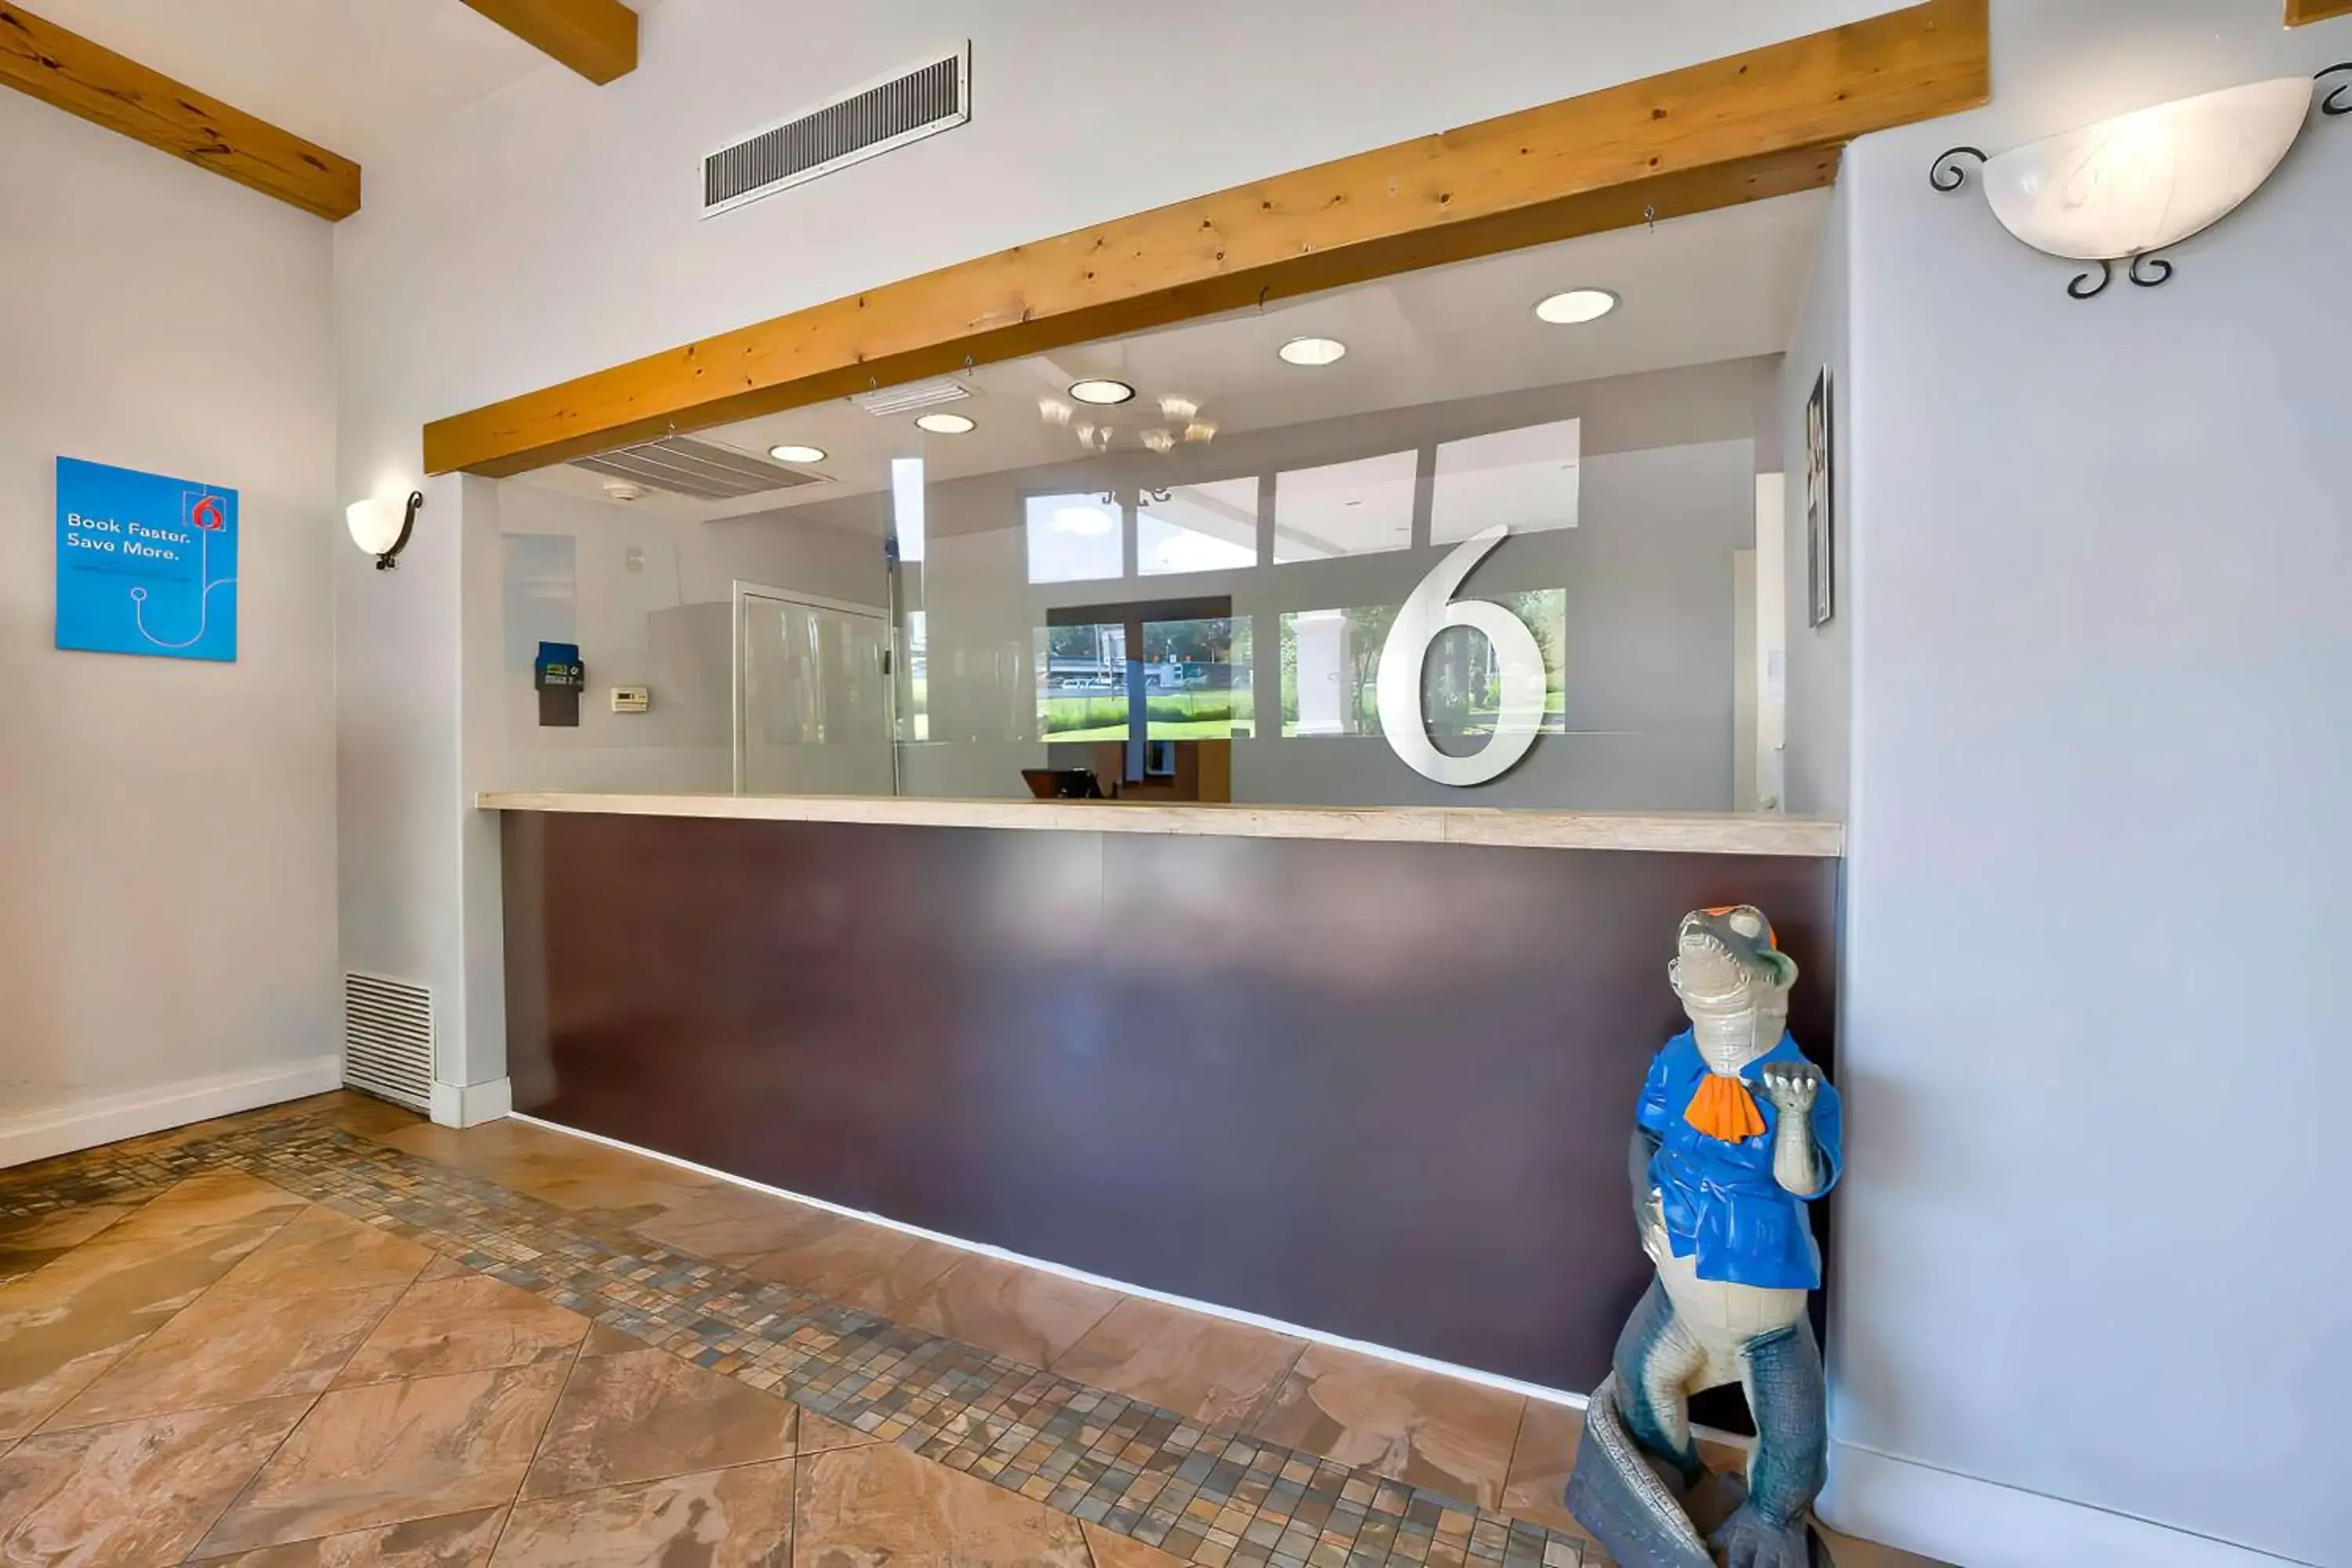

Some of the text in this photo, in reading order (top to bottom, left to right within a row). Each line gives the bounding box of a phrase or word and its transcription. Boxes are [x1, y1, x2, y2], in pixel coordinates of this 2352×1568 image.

[193, 495, 223, 529] 6
[67, 514, 191, 543] Book Faster.
[67, 533, 180, 561] Save More.
[1377, 524, 1546, 786] 6
